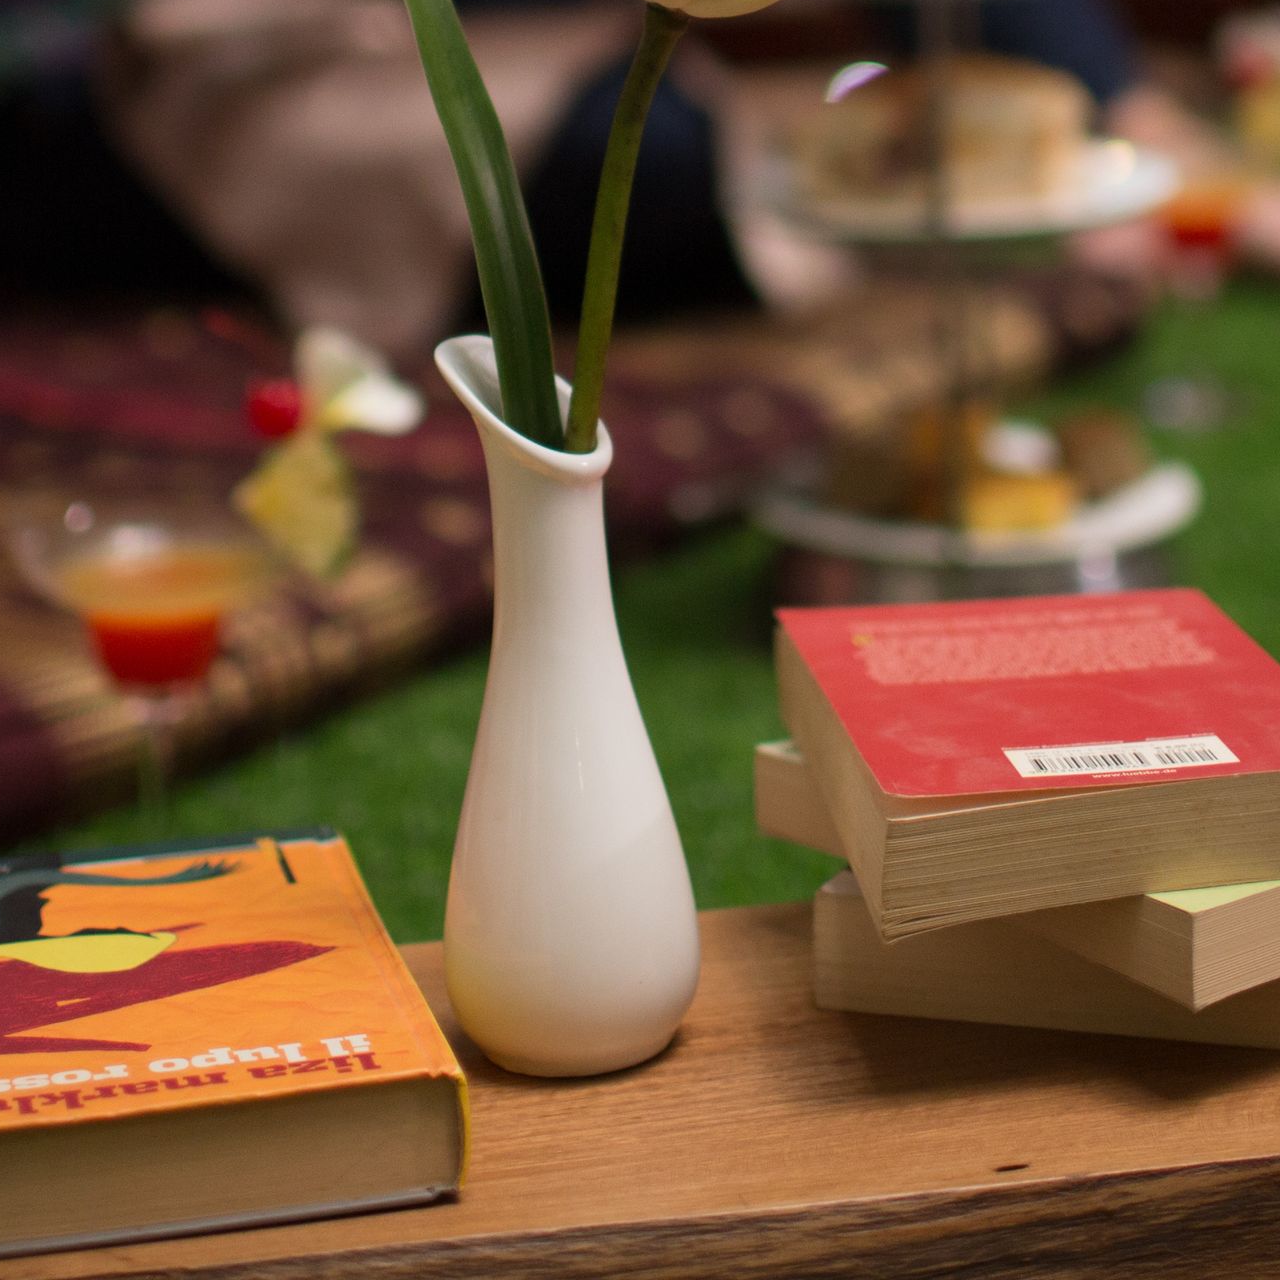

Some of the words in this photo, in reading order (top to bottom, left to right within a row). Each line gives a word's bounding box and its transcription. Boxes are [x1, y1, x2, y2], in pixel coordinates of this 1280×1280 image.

[149, 1039, 306, 1073] lupo
[320, 1033, 371, 1058] il
[247, 1051, 383, 1080] liza
